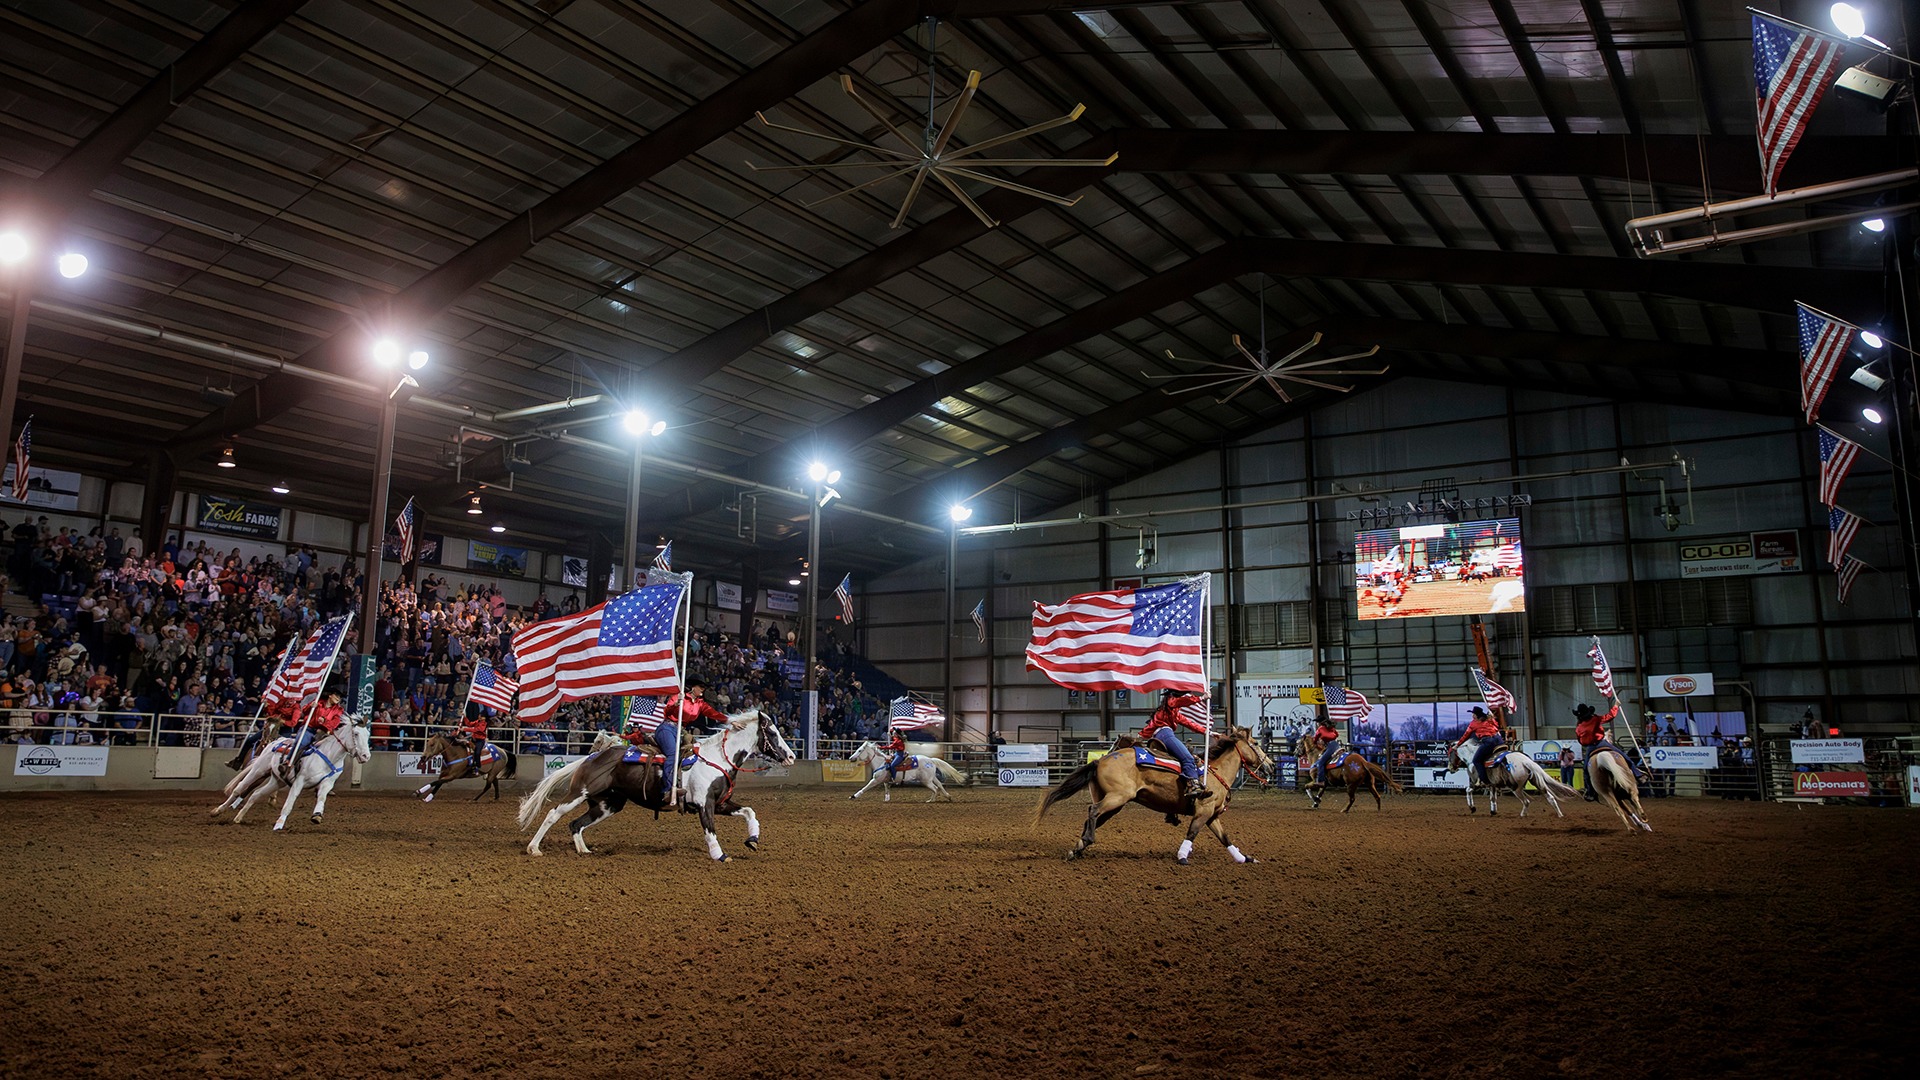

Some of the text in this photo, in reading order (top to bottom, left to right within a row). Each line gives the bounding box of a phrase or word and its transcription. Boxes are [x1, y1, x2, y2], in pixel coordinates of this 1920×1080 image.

[203, 502, 245, 522] Tosh
[245, 513, 279, 527] FARMS
[1682, 544, 1749, 558] CO-OP
[1684, 565, 1699, 576] Your
[1700, 564, 1733, 572] hometown
[362, 657, 376, 716] LA CAB
[1277, 684, 1313, 697] ROBIN
[1669, 680, 1694, 691] Tyson
